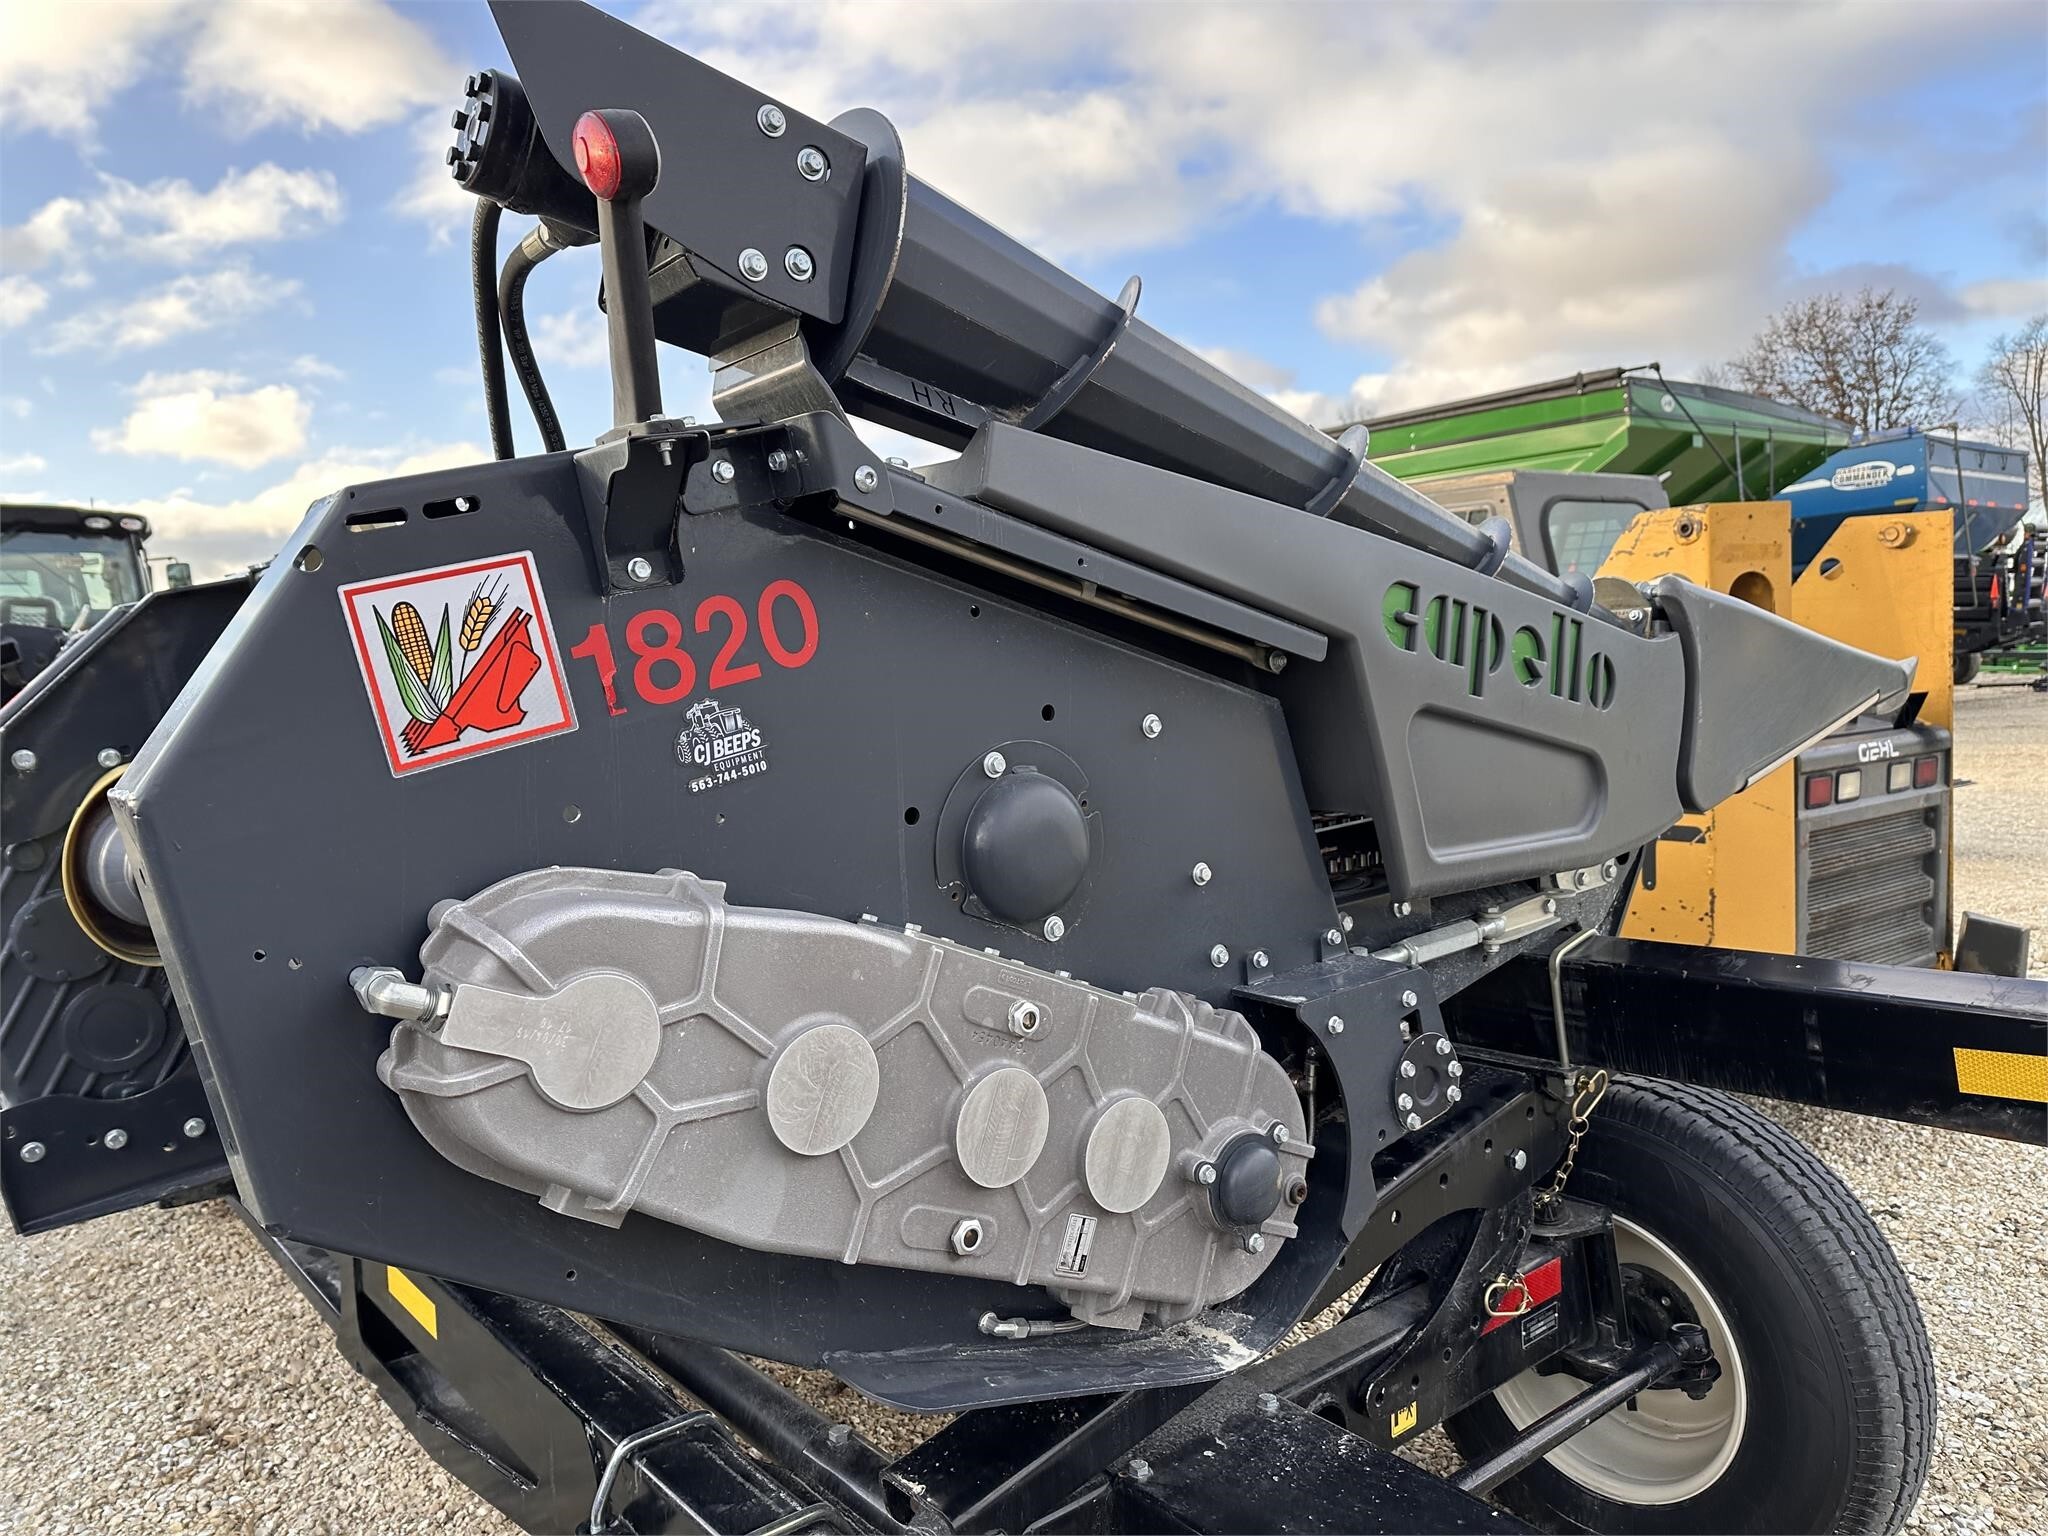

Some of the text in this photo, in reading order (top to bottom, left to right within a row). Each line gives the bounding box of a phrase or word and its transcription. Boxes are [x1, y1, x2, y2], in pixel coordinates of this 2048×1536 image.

[911, 381, 956, 416] RH
[570, 580, 819, 717] 1820
[694, 728, 761, 766] CJ BEEPS
[714, 750, 764, 772] EQUIPMENT
[1857, 739, 1900, 763] GEHL
[691, 760, 767, 793] 563-744-5010
